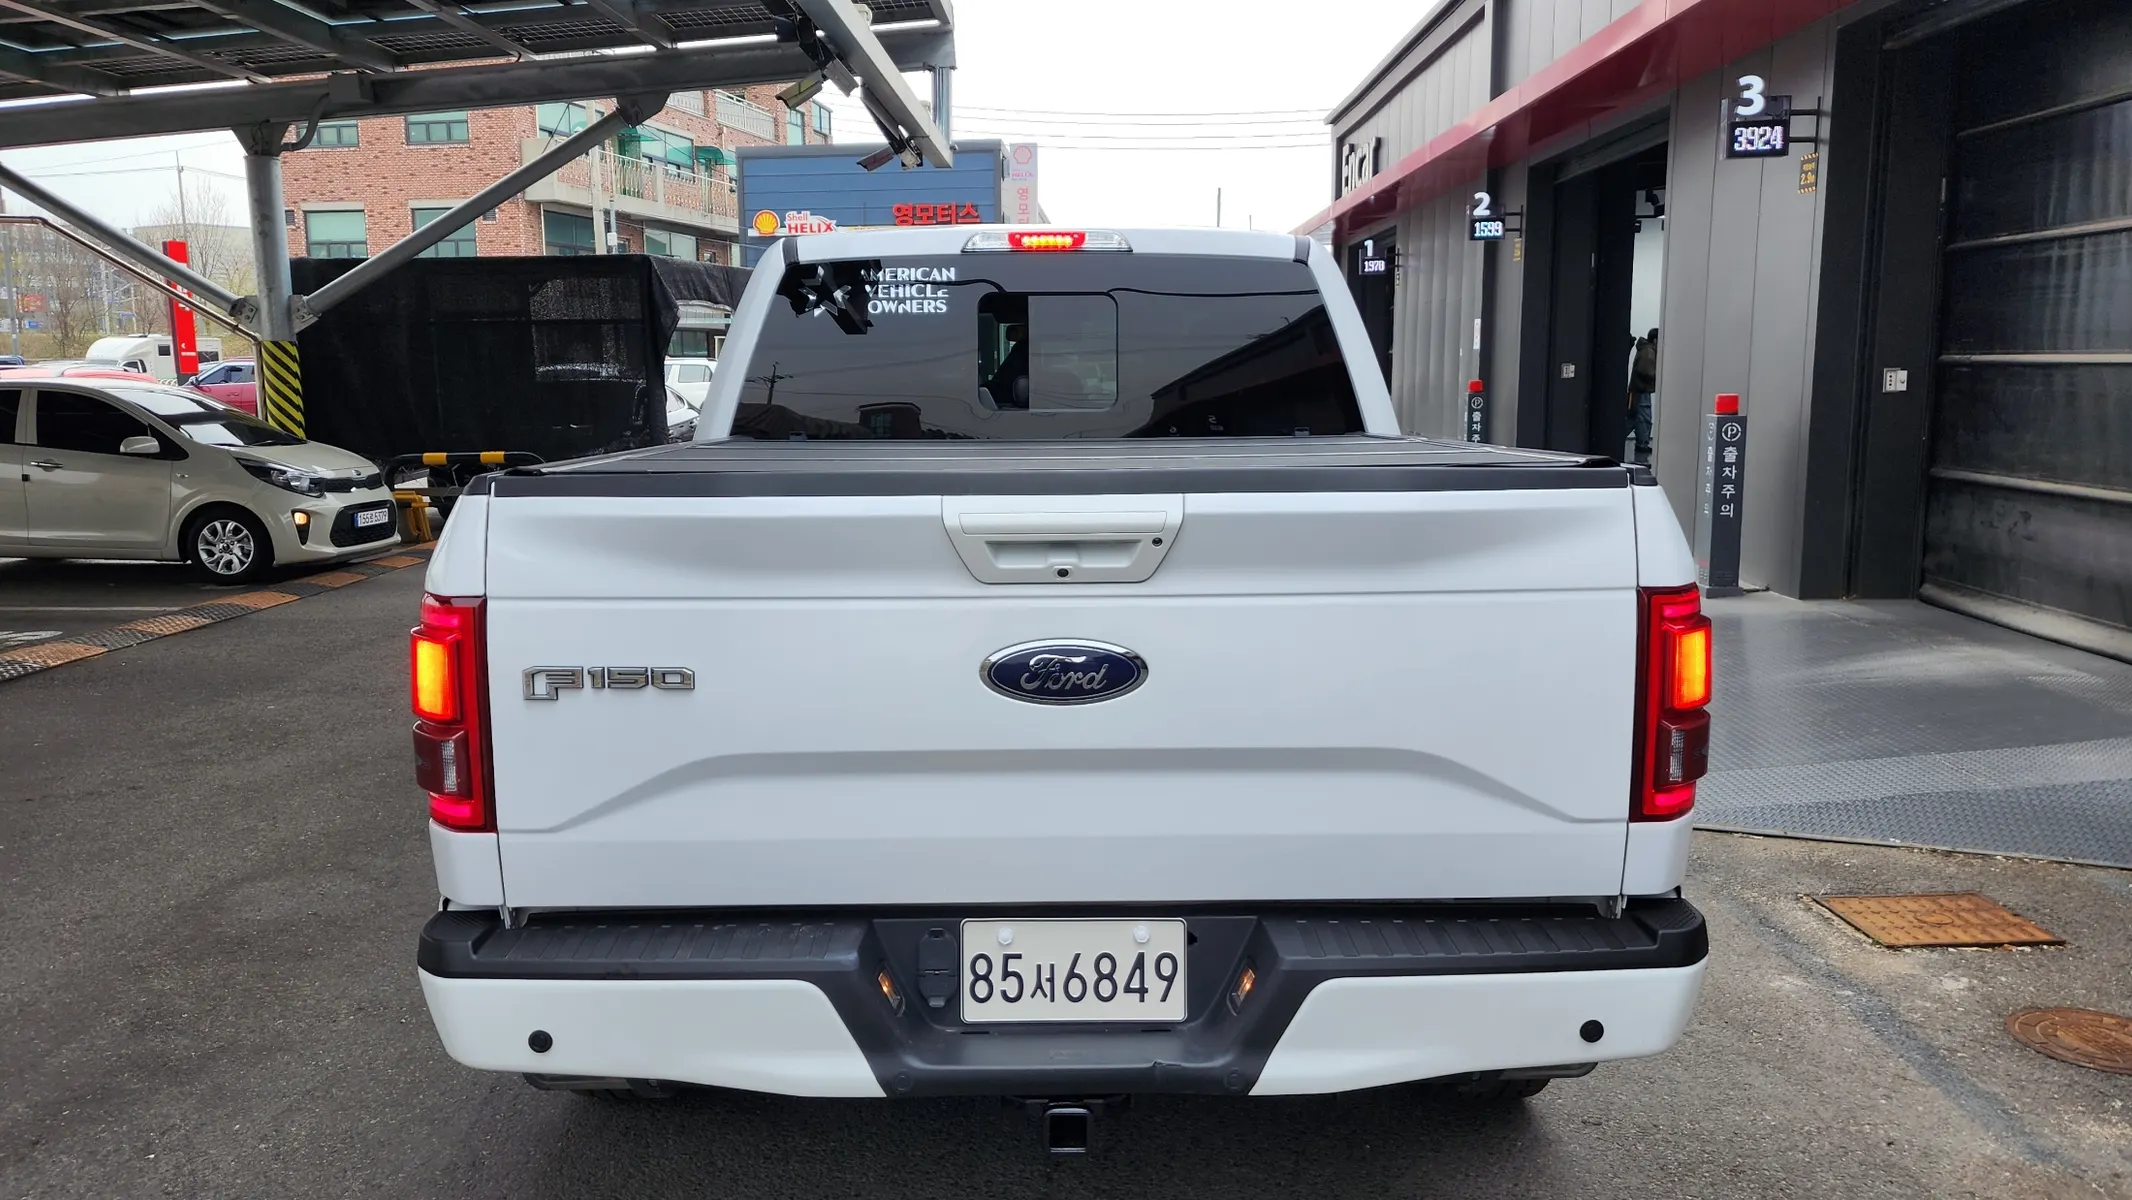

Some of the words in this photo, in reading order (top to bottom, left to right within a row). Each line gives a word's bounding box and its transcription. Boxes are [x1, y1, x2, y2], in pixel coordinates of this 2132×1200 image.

[1736, 75, 1765, 116] 3
[1734, 126, 1784, 152] 3924
[1473, 191, 1491, 216] 2
[787, 213, 808, 221] Shell
[892, 202, 981, 227] 영모터스
[787, 221, 834, 234] HELIX
[1474, 221, 1503, 237] 1599
[1364, 239, 1374, 257] 1
[861, 267, 956, 281] AMERICAN
[864, 284, 949, 298] VEHICLE
[867, 299, 947, 314] OWNERS
[1720, 446, 1739, 518] 출차주의
[1020, 654, 1109, 690] Ford
[969, 951, 1179, 1004] 85서6849
